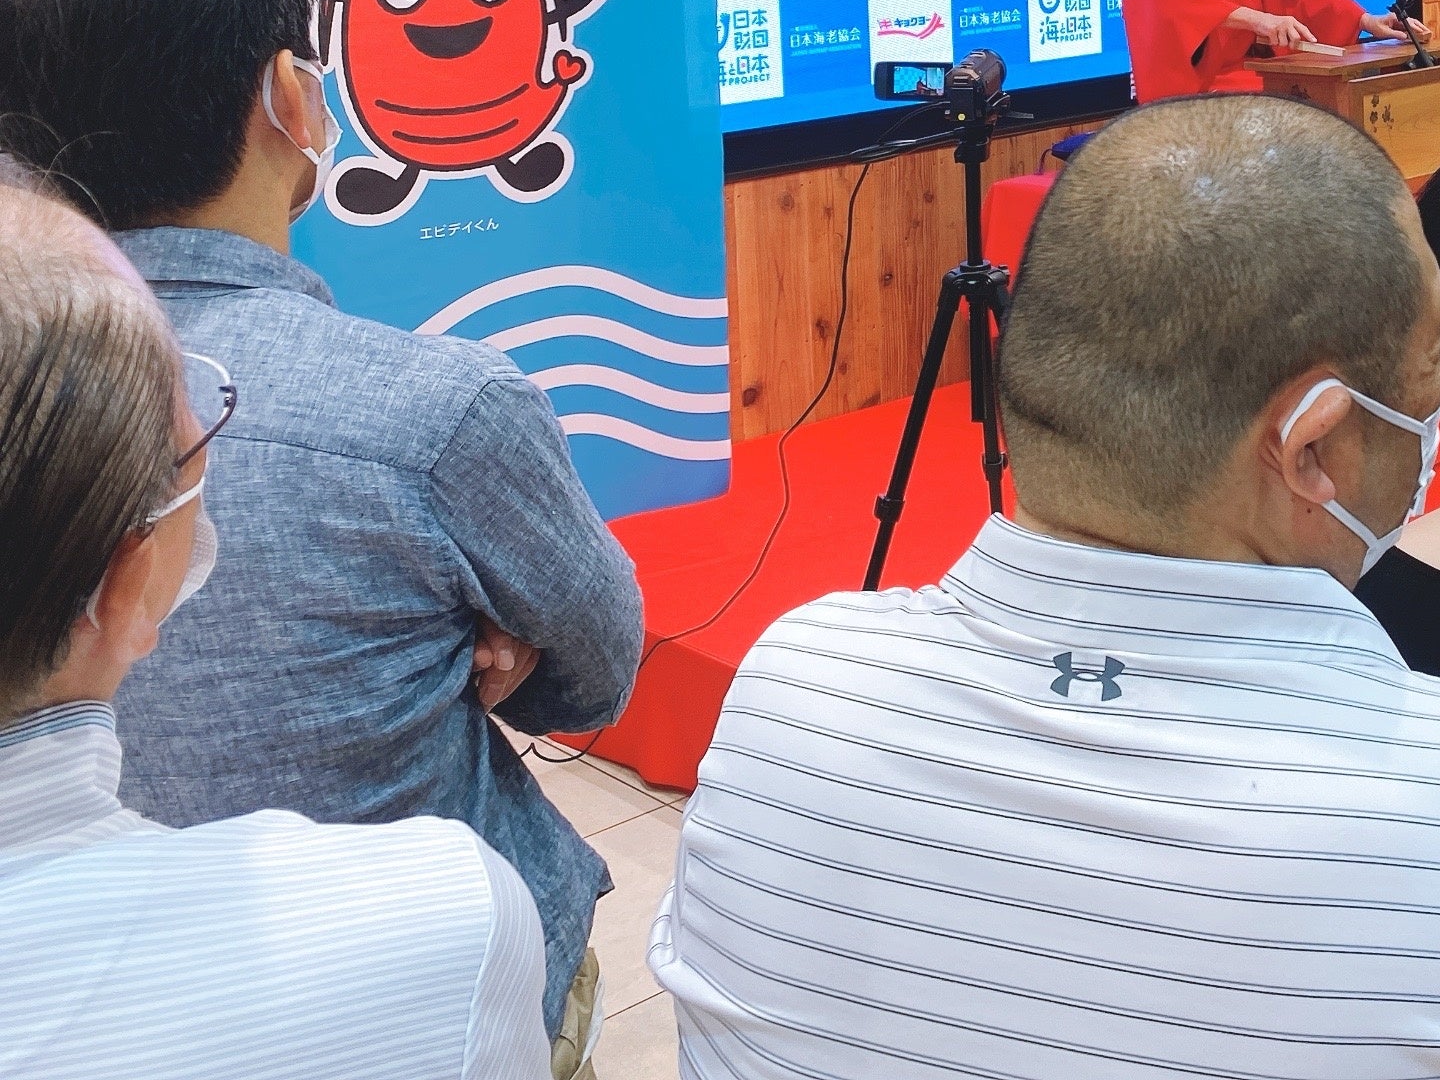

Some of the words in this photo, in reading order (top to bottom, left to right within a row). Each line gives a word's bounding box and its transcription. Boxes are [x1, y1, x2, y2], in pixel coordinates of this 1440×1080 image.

[733, 8, 768, 30] 日本
[959, 8, 1022, 28] 日本海老協会
[733, 29, 769, 51] 財団
[789, 27, 861, 49] 日本海老協会
[1039, 14, 1093, 46] 海と日本
[1060, 32, 1093, 43] PROJECT
[728, 73, 771, 86] PROJECT
